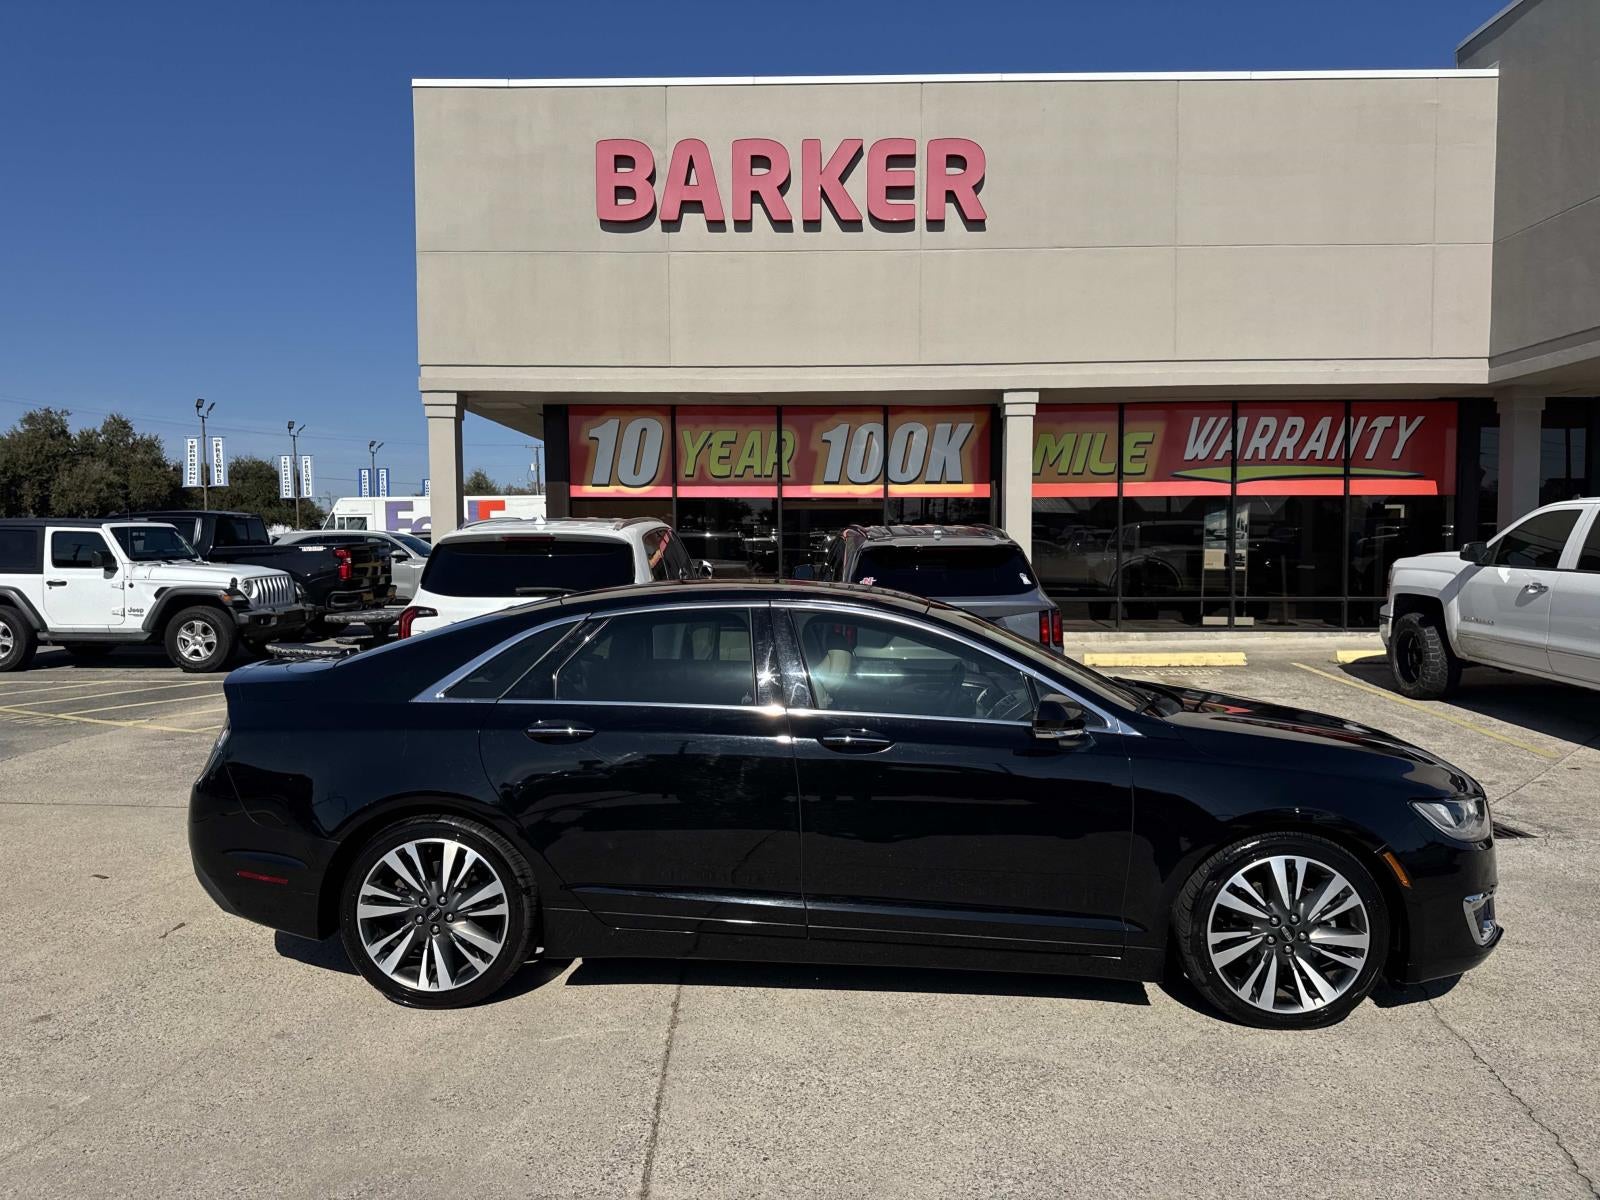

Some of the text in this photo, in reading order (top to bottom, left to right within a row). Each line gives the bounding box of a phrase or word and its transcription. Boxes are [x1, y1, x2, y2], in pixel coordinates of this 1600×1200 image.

[596, 138, 988, 222] BARKER
[588, 415, 1426, 488] 10 YEAR 100K MILE WARRANTY
